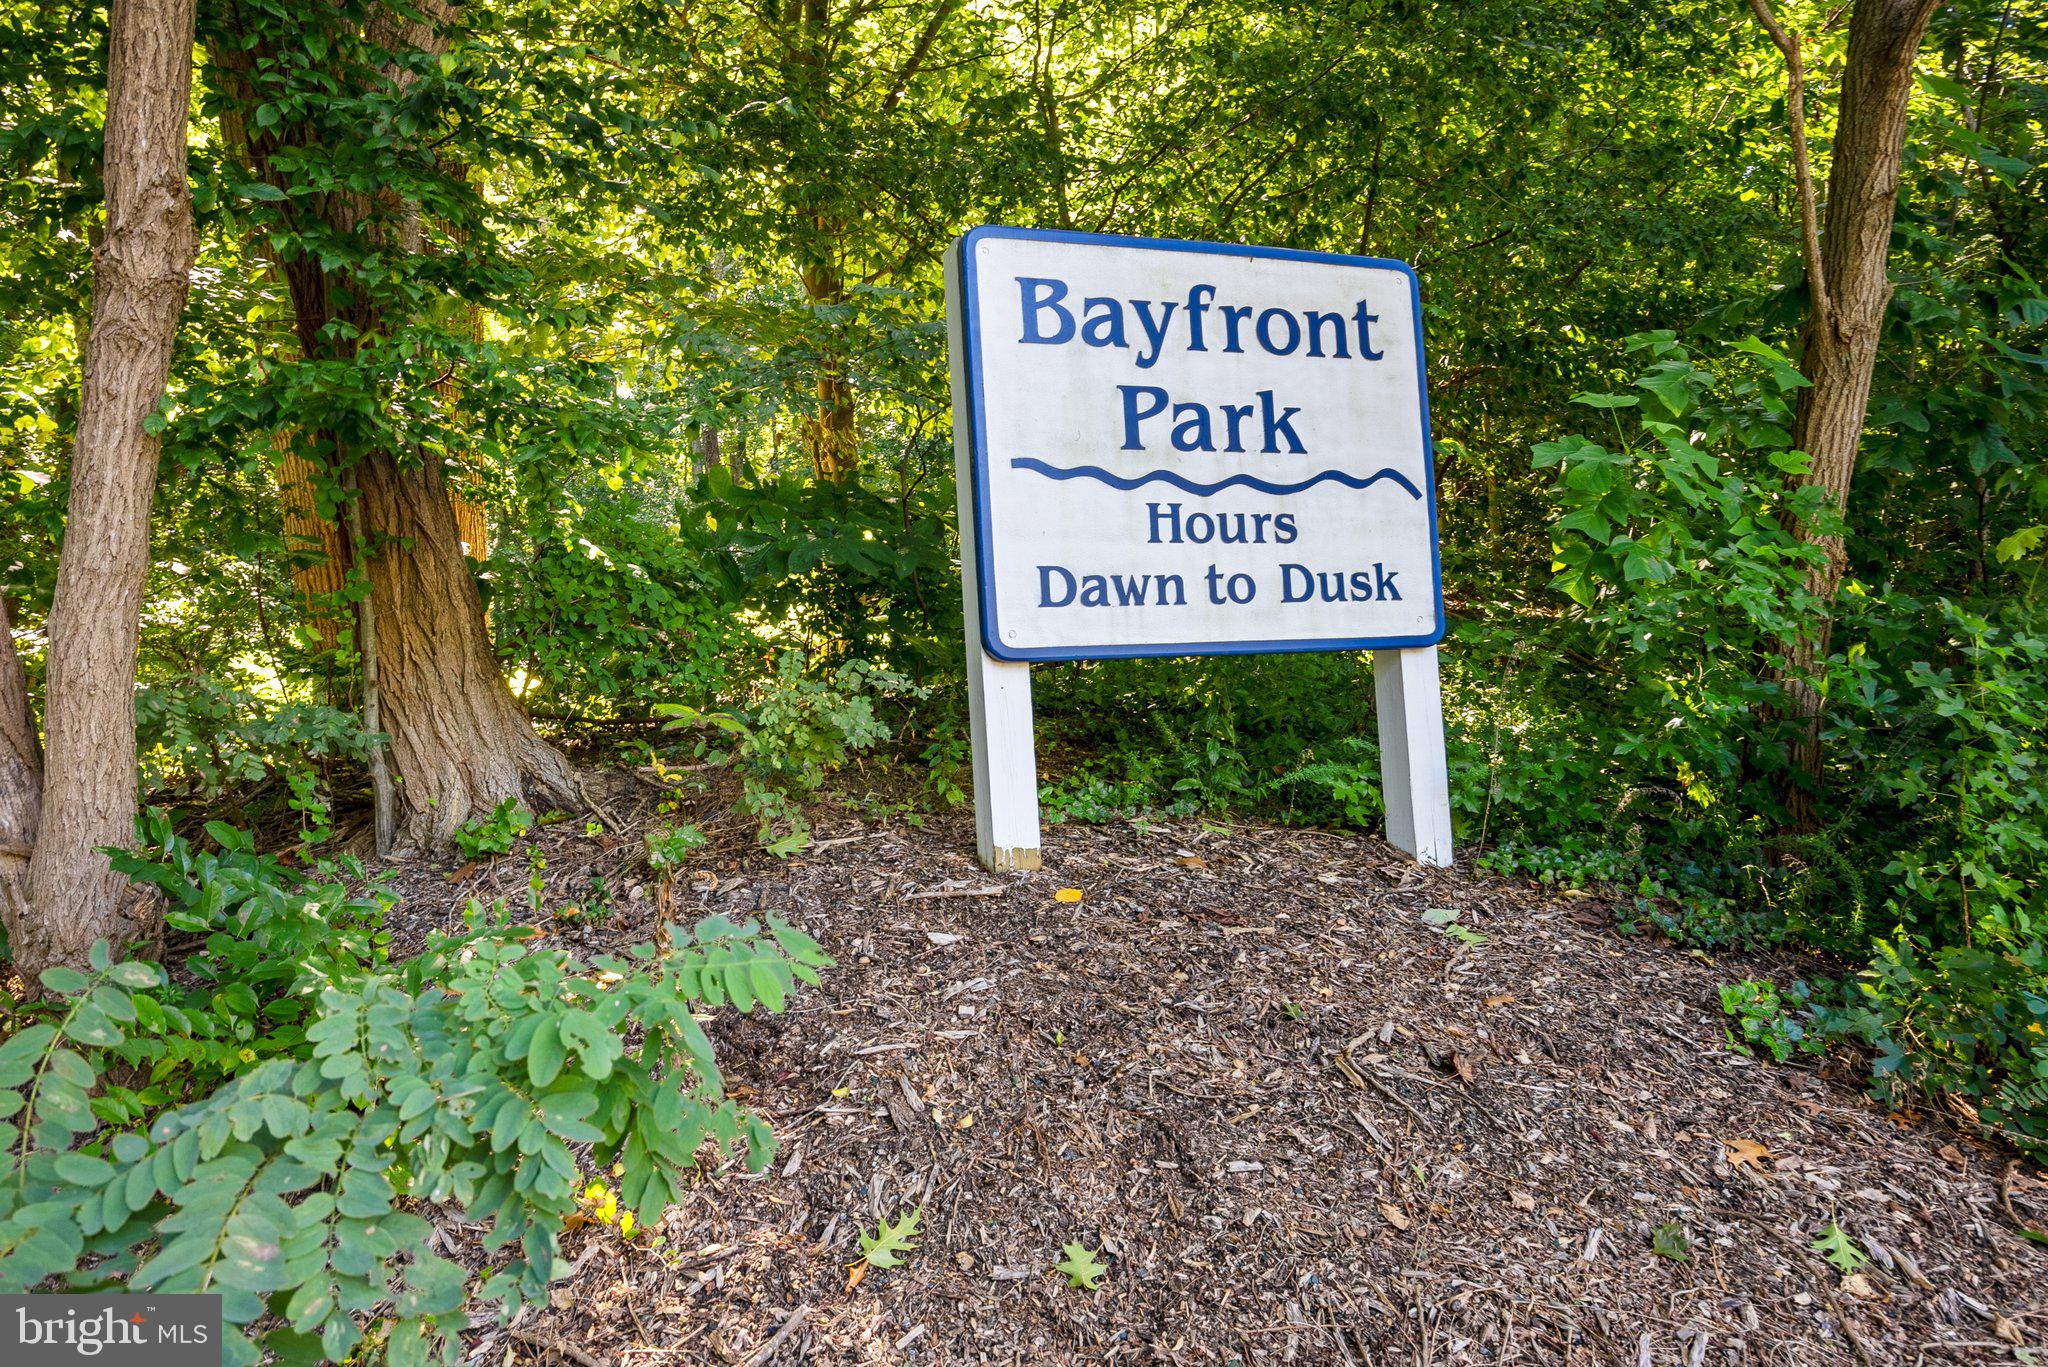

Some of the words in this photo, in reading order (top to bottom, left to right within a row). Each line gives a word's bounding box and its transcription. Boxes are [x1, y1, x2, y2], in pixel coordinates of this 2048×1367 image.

[1015, 276, 1385, 369] Bayfront
[1116, 384, 1309, 455] Park
[1145, 502, 1299, 545] Hours
[1036, 565, 1188, 608] Dawn
[1204, 563, 1257, 606] to
[1279, 562, 1403, 604] Dusk
